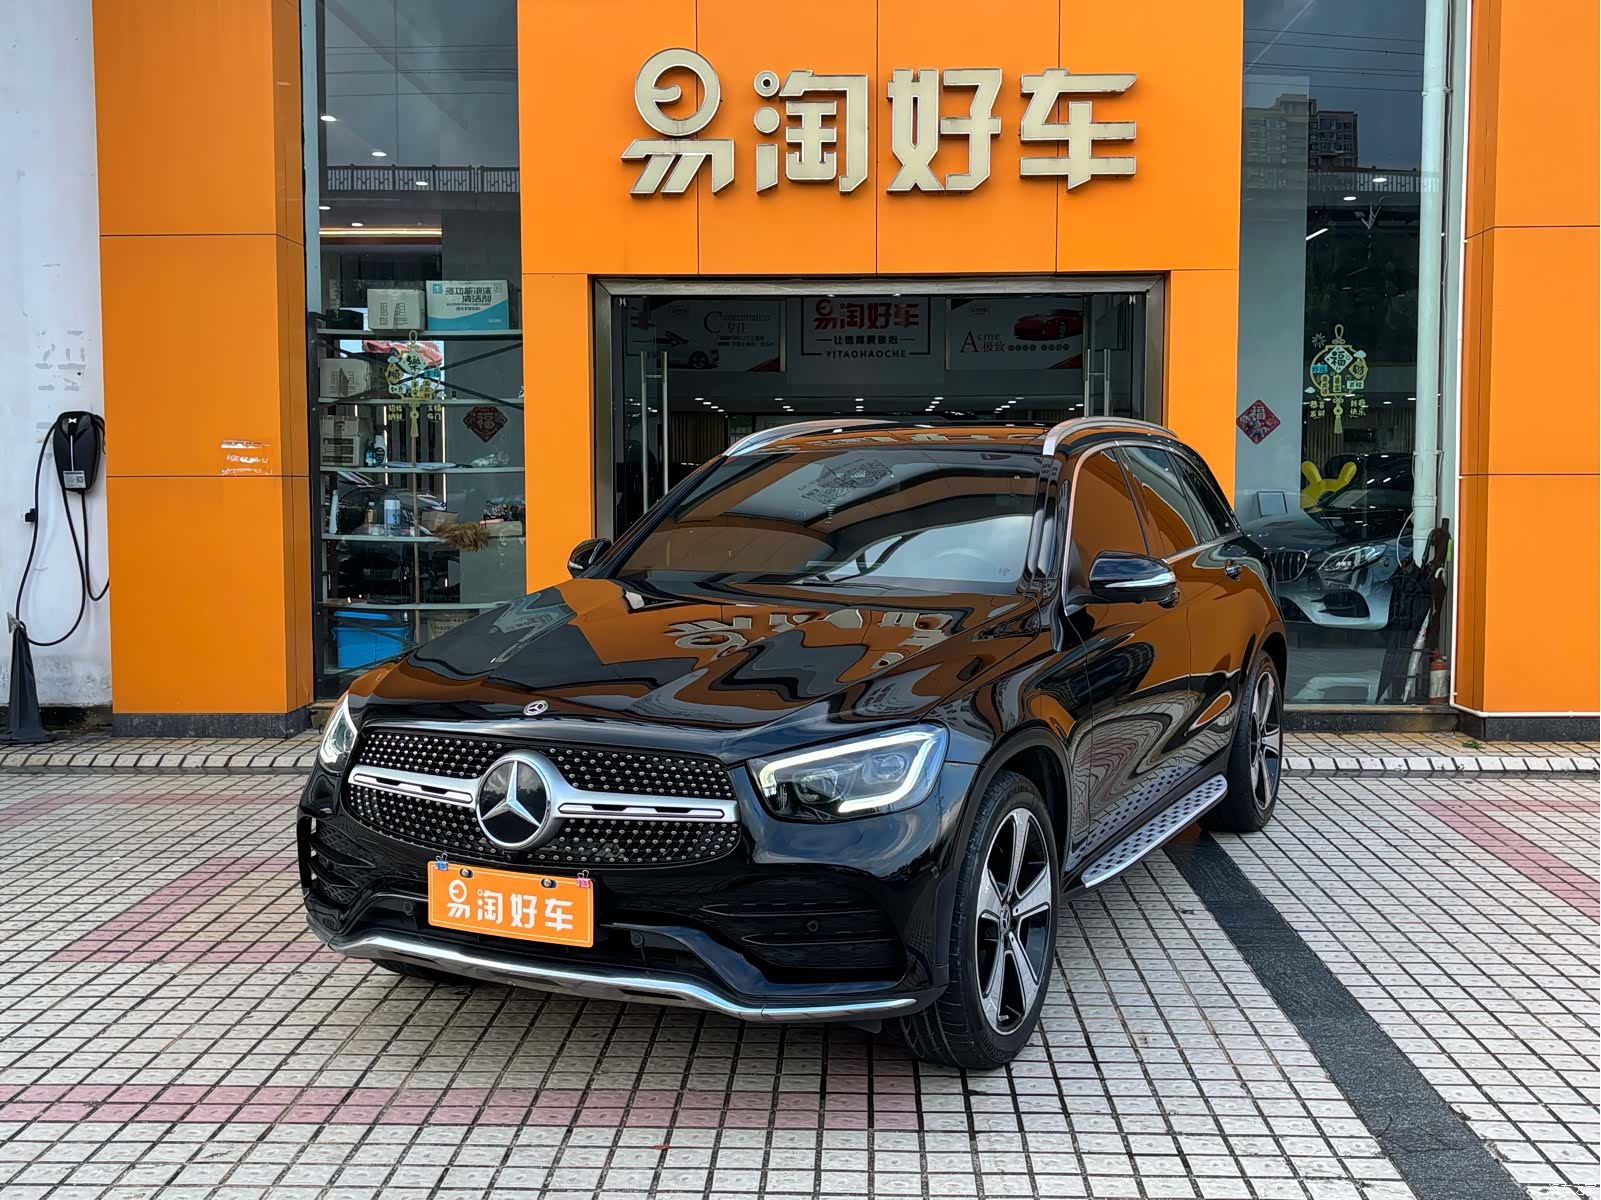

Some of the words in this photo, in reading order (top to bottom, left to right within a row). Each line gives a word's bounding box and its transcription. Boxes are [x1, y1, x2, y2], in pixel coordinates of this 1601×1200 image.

[621, 47, 1137, 194] 易淘好车
[444, 286, 492, 295] 多功能泡沫
[462, 295, 492, 303] 清洁剂
[813, 298, 920, 330] 易淘好车
[825, 349, 907, 359] YITAOHAOCHE
[1330, 350, 1347, 367] 福
[1249, 406, 1266, 420] 福
[446, 879, 574, 932] 易淘好车
